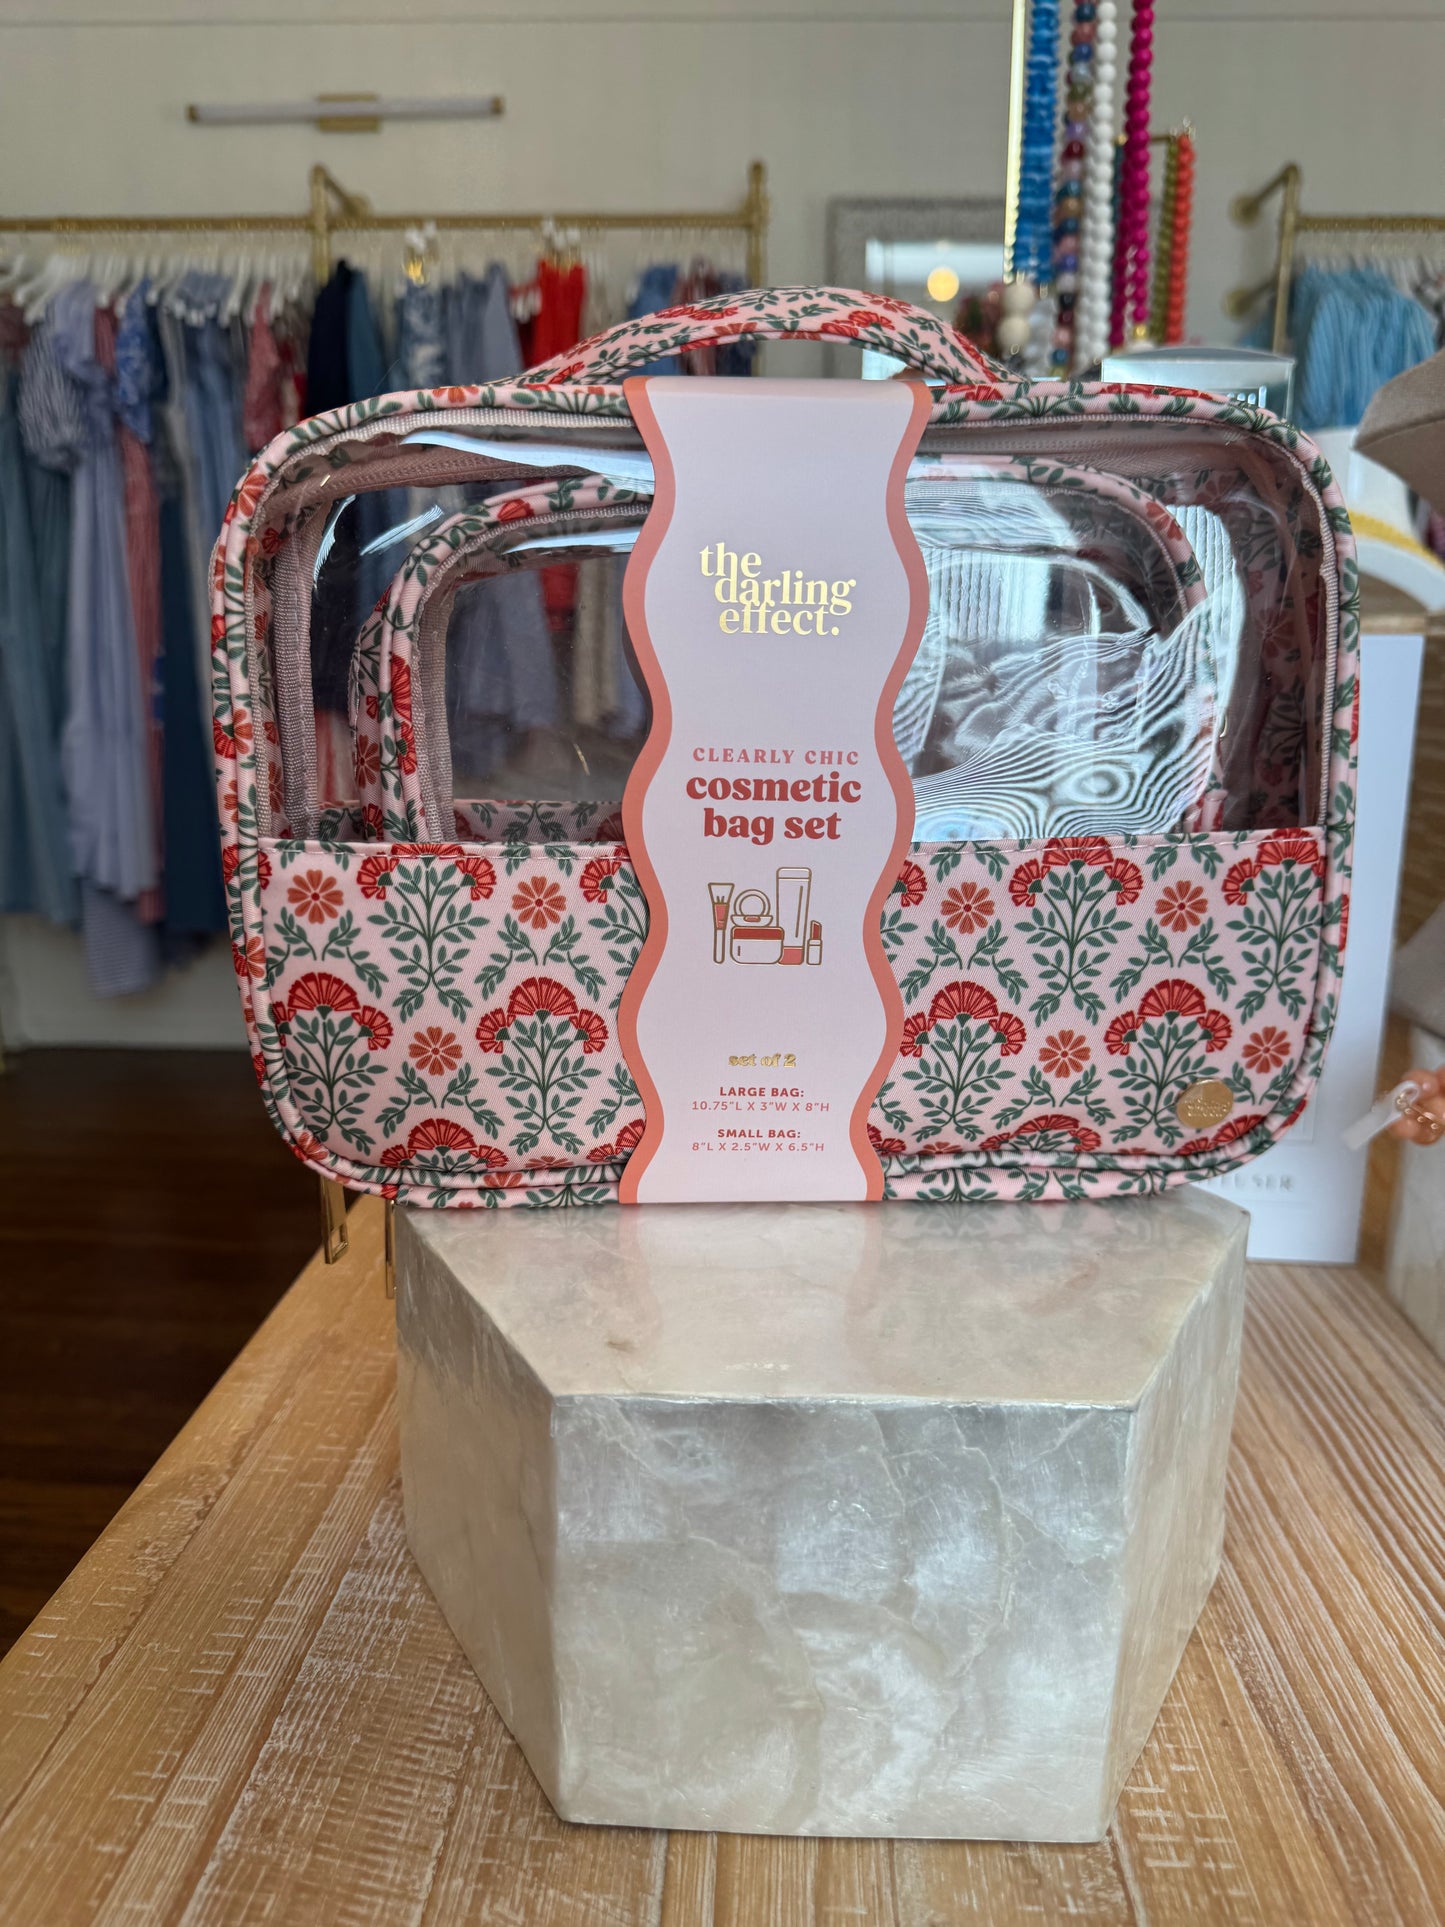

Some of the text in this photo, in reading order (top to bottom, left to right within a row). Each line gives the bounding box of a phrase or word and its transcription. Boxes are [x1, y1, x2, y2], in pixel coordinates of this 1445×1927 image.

[699, 542, 762, 578] the
[714, 570, 857, 616] darling
[719, 600, 840, 636] effect.
[692, 747, 860, 766] CLEARLY CHIC
[685, 770, 862, 804] cosmetic
[703, 807, 842, 846] bag set
[727, 1053, 797, 1068] set of 2
[719, 1086, 805, 1098] LARGE BAG:
[747, 1101, 755, 1112] X
[792, 1102, 800, 1112] X
[717, 1128, 801, 1139] SMALL BAG:
[718, 1142, 727, 1152] X
[775, 1142, 784, 1152] X
